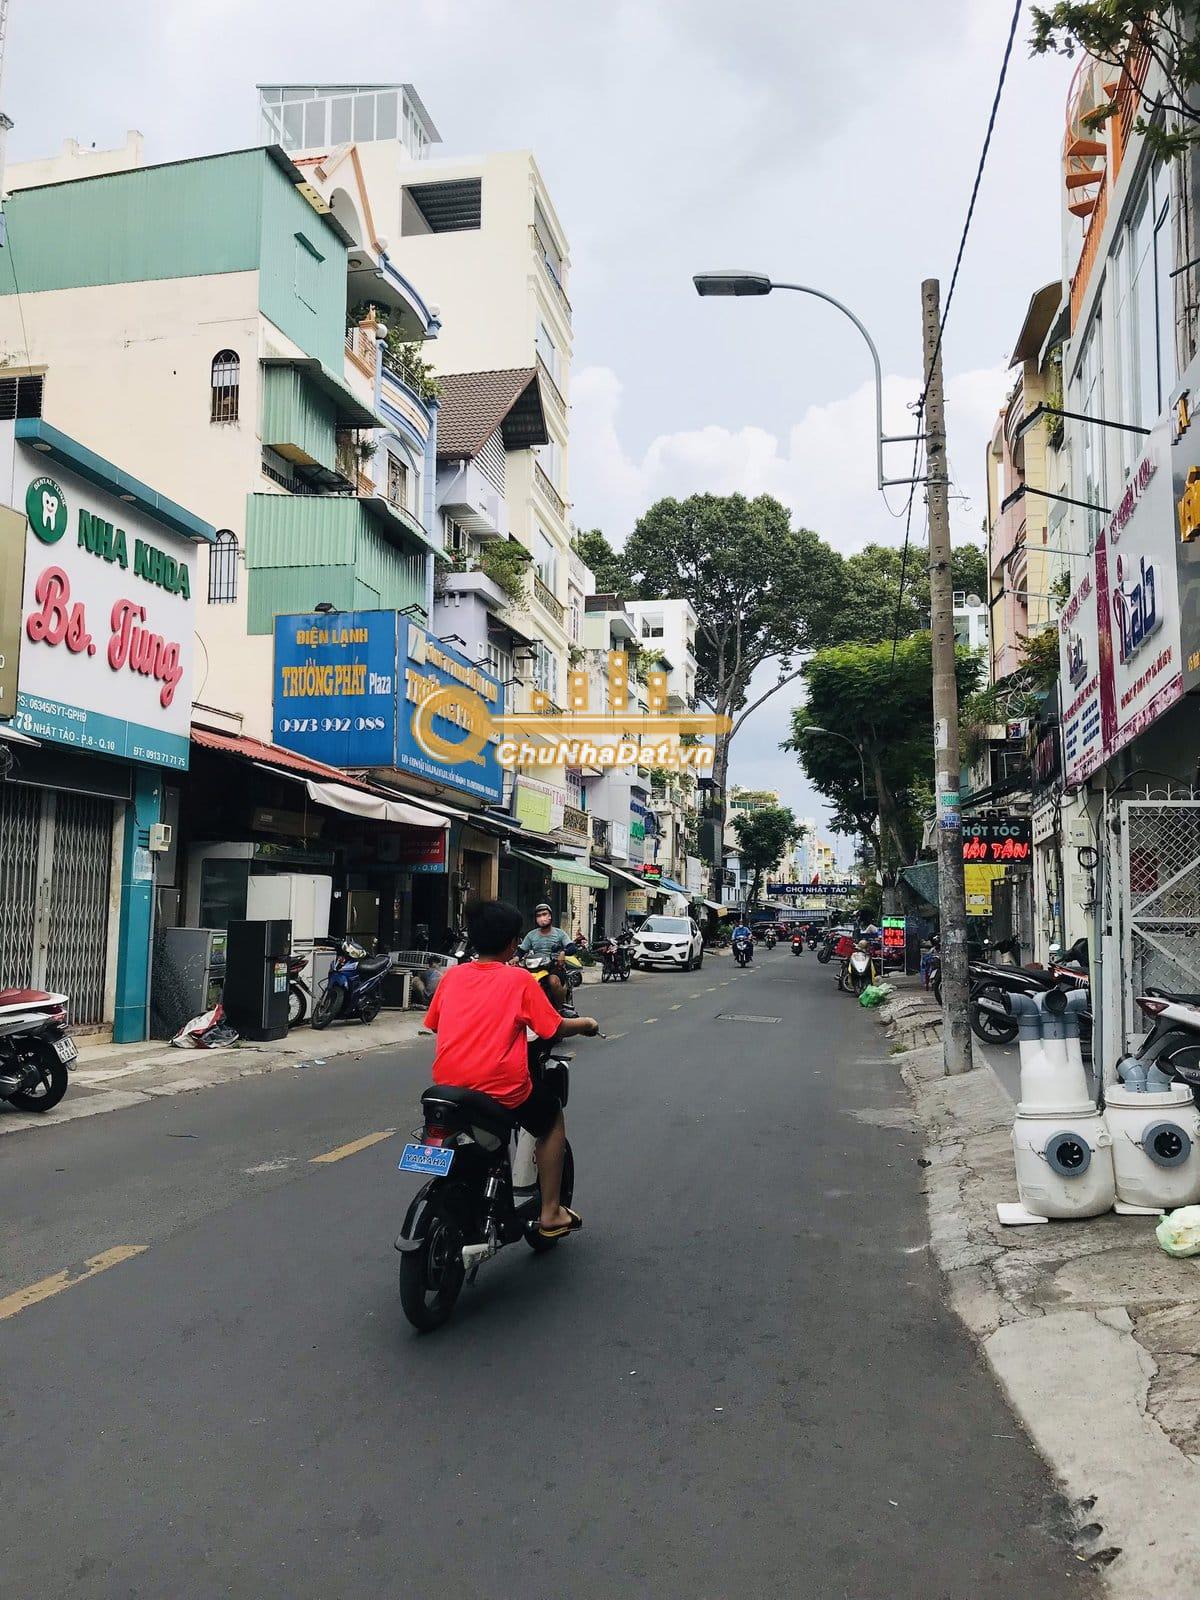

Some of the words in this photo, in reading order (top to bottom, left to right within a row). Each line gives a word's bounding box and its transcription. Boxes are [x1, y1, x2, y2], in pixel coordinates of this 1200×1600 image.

[78, 508, 128, 570] NHA
[133, 538, 191, 600] KHOA
[26, 565, 97, 657] Bs.
[107, 598, 184, 709] Tùng
[296, 626, 329, 648] ĐIỆN
[332, 628, 368, 648] LẠNH
[282, 657, 334, 697] TRƯỜNG
[334, 656, 367, 695] PHÁT
[369, 672, 392, 695] Plaza
[279, 718, 318, 732] 0973
[321, 717, 352, 732] 992
[354, 716, 385, 731] 088
[32, 722, 57, 738] NHẬT
[58, 726, 75, 741] TẢO
[81, 734, 93, 746] P.8
[98, 738, 116, 751] Q.10
[133, 746, 145, 757] ĐT:
[145, 749, 161, 761] 0913
[178, 757, 185, 767] 75
[962, 822, 988, 836] HỚT
[992, 822, 1020, 836] TÓC
[991, 838, 1028, 859] TÂN
[405, 1153, 447, 1168] YAMAHA
